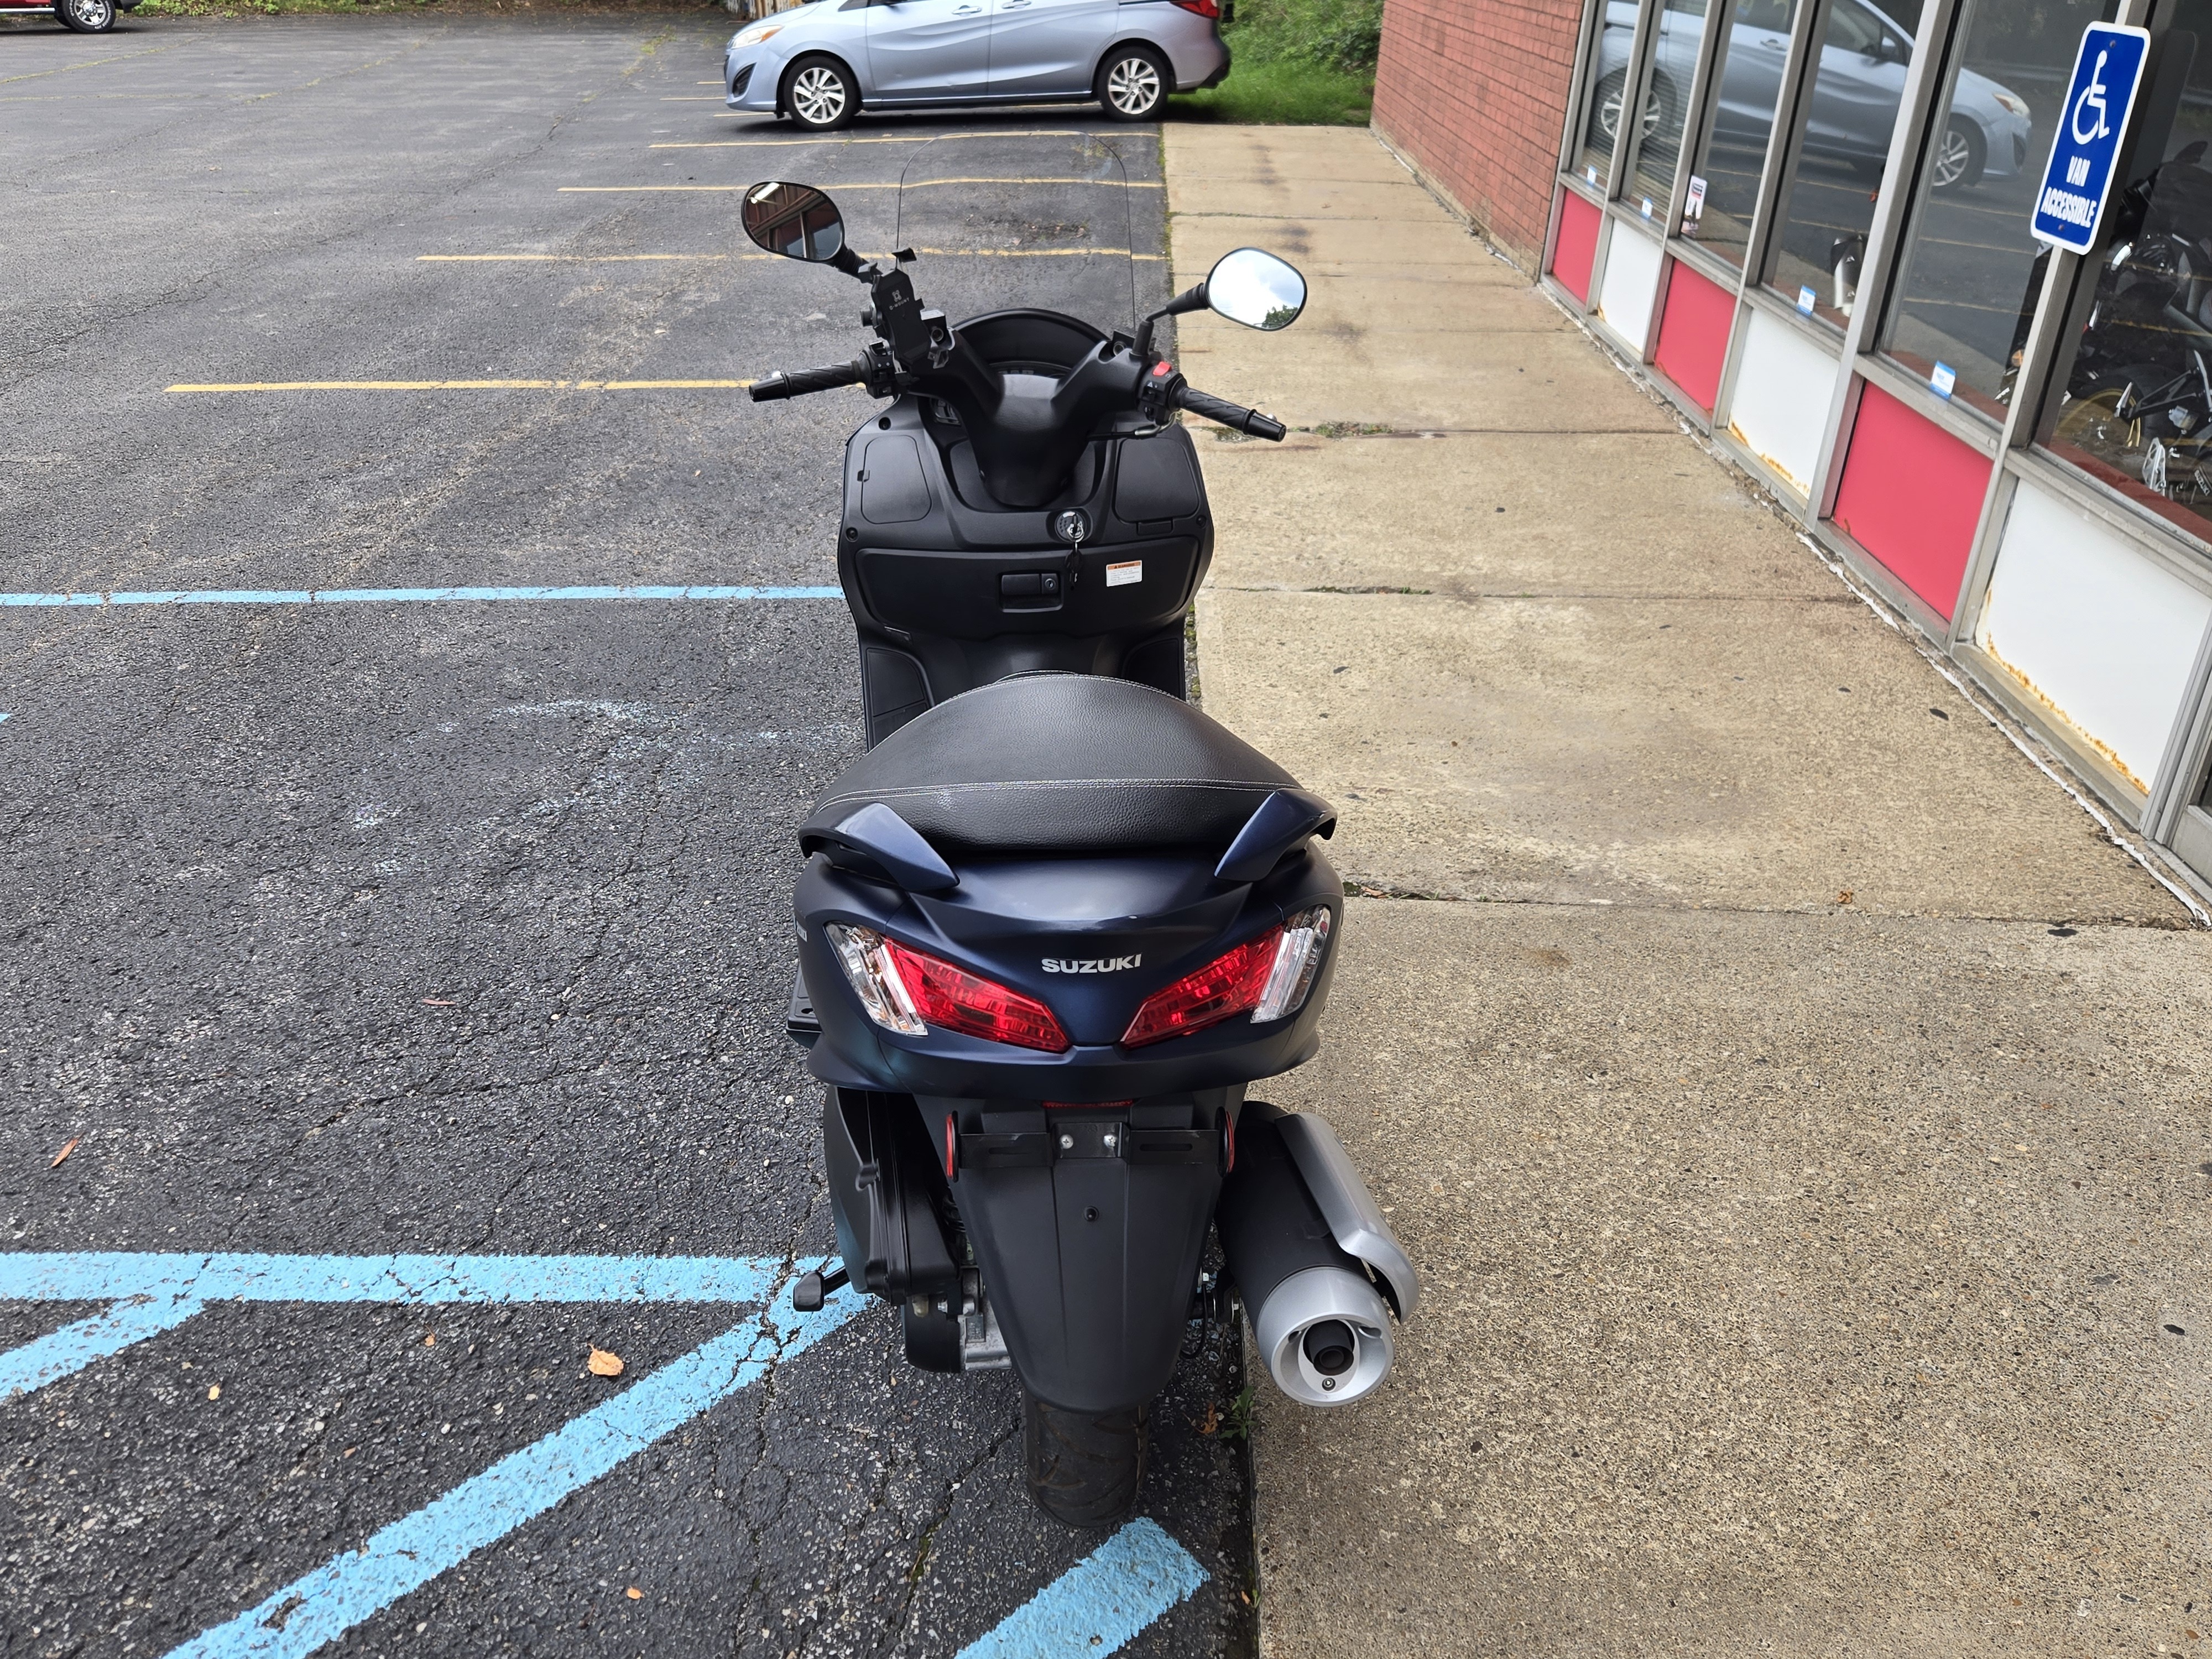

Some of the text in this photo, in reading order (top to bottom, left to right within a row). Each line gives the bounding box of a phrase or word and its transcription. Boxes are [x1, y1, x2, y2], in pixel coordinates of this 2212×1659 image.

[2066, 156, 2091, 186] VAN
[2041, 187, 2097, 228] ACCESSIBLE
[1041, 954, 1142, 973] SUZUKI
